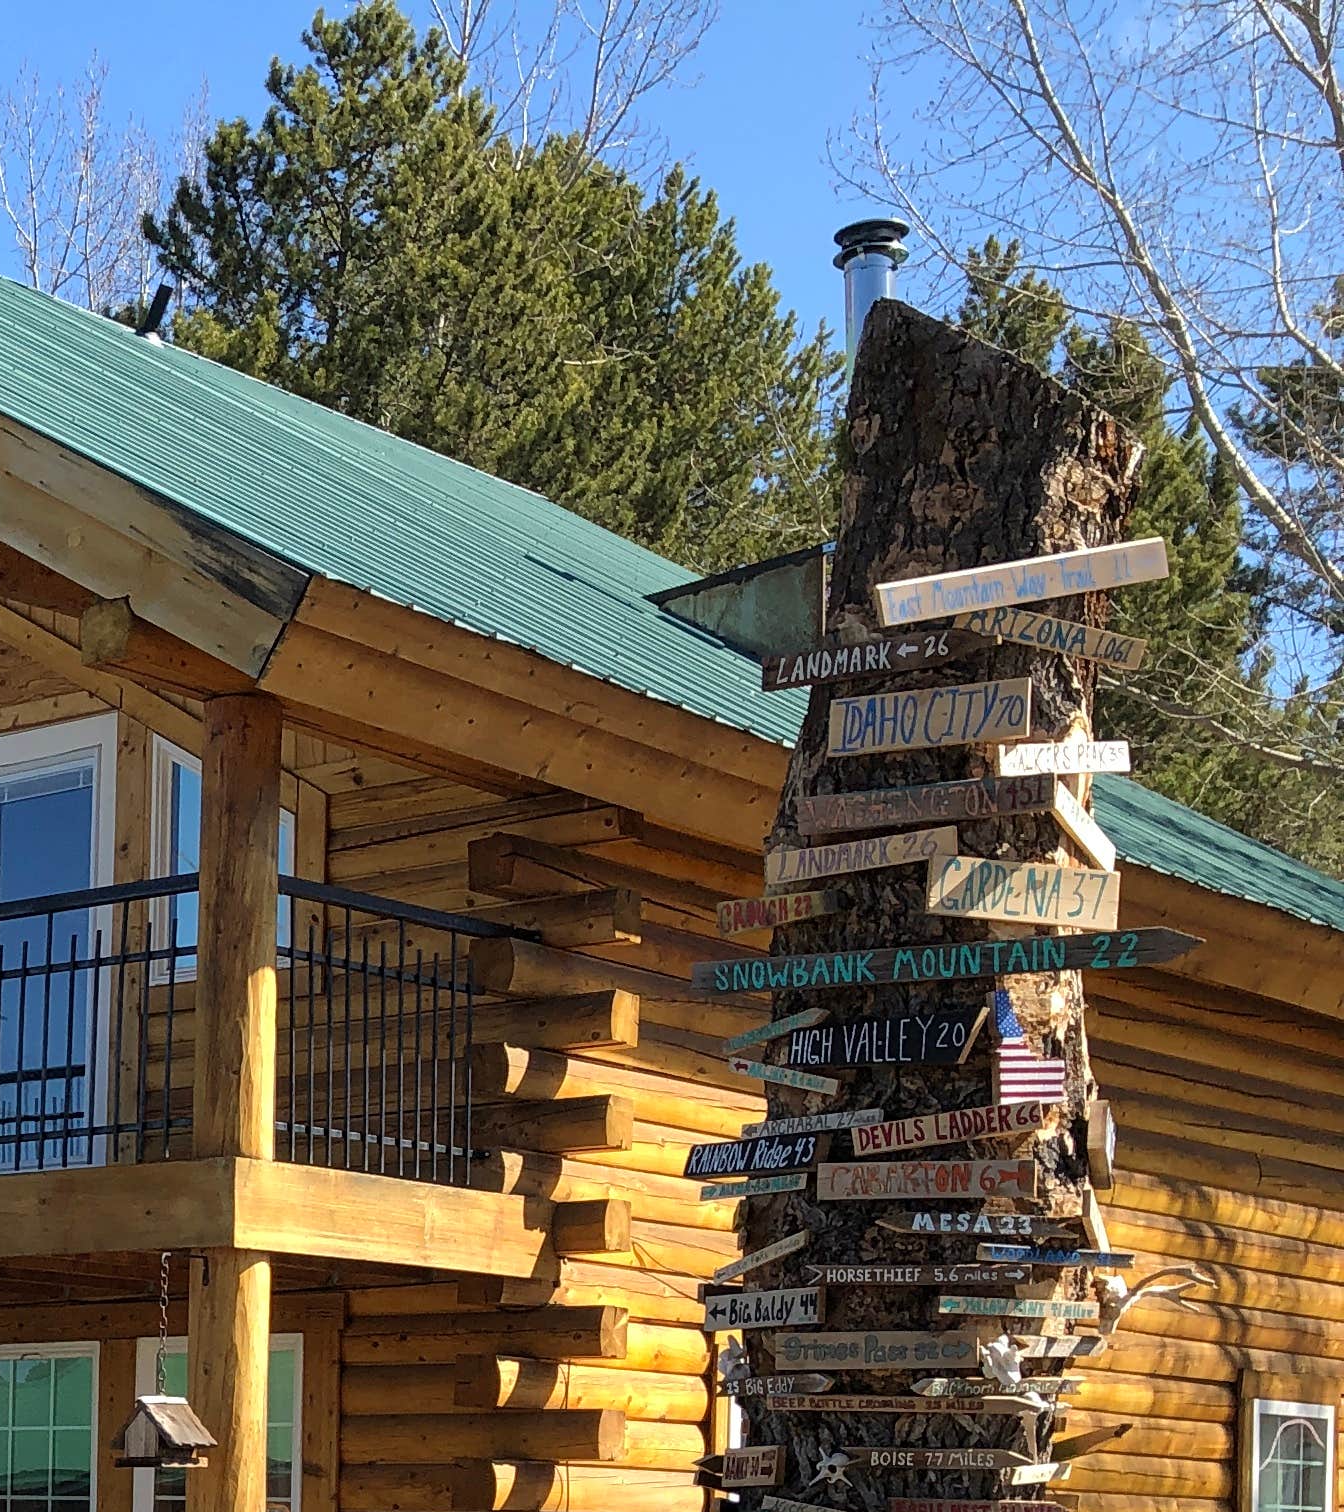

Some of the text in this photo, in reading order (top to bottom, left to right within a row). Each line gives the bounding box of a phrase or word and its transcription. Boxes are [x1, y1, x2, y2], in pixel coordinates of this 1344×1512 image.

[931, 573, 1006, 612] Mountain
[965, 606, 1087, 652] ARIZONA
[776, 632, 949, 685] LANDMARK 26
[832, 682, 1025, 754] IDAHO CITY 70
[777, 831, 939, 883] LANDMARK 26
[939, 857, 1110, 921] GARDENA 37
[714, 931, 1140, 992] SNOWBANK MOUNTAIN 22
[789, 1027, 834, 1066] HIGH
[842, 1013, 936, 1064] VALLEY
[935, 1020, 967, 1049] 20
[858, 1103, 1042, 1152] DEVILS LADDER 66
[687, 1136, 817, 1175] RAINBOW Ridge 43
[978, 1164, 997, 1195] 6
[911, 1211, 1034, 1235] MESA 23
[826, 1267, 999, 1284] HORSETHIEF 5.6 miles
[799, 1292, 818, 1316] 44
[869, 1450, 915, 1468] BOISE
[923, 1450, 945, 1467] 77
